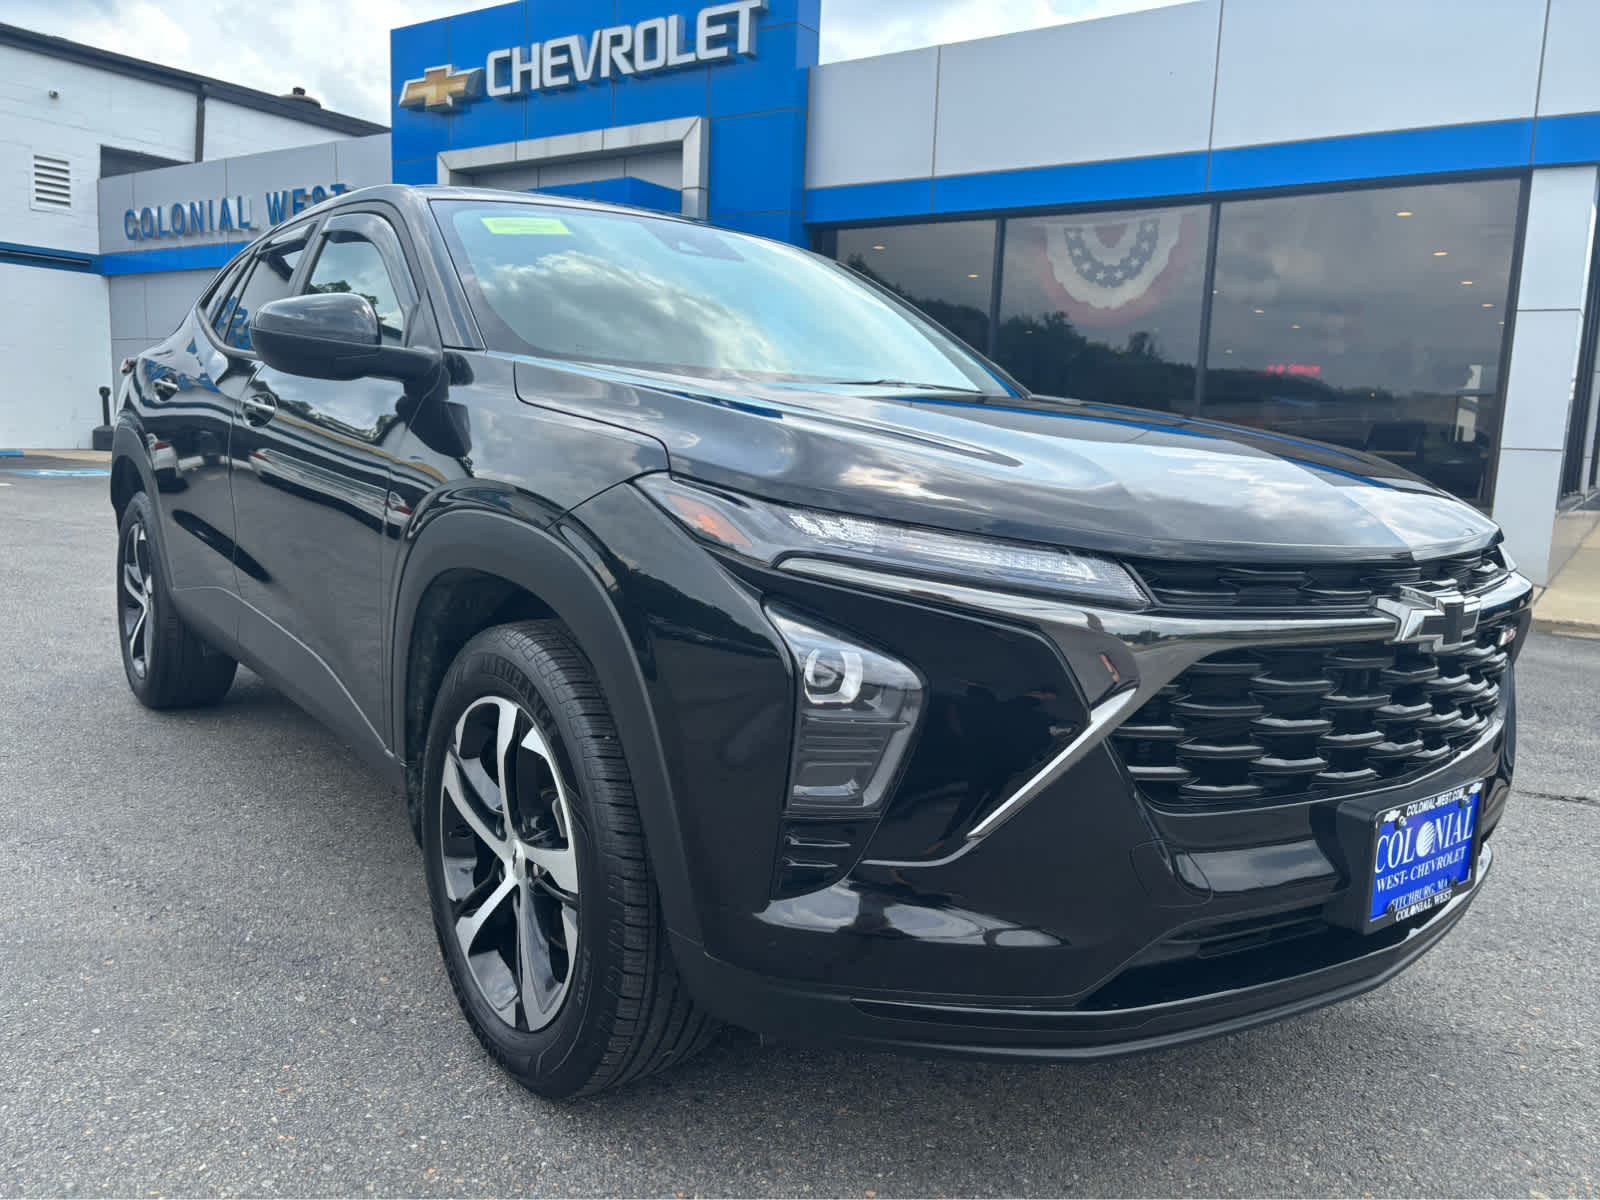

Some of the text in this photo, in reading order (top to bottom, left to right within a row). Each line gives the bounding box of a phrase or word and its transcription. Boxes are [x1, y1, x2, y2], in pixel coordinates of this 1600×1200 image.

[485, 0, 768, 98] CHEVROLET
[123, 195, 253, 241] COLONIAL
[1374, 805, 1474, 874] COLONIAL
[1395, 889, 1453, 922] COLONIAL WEST
